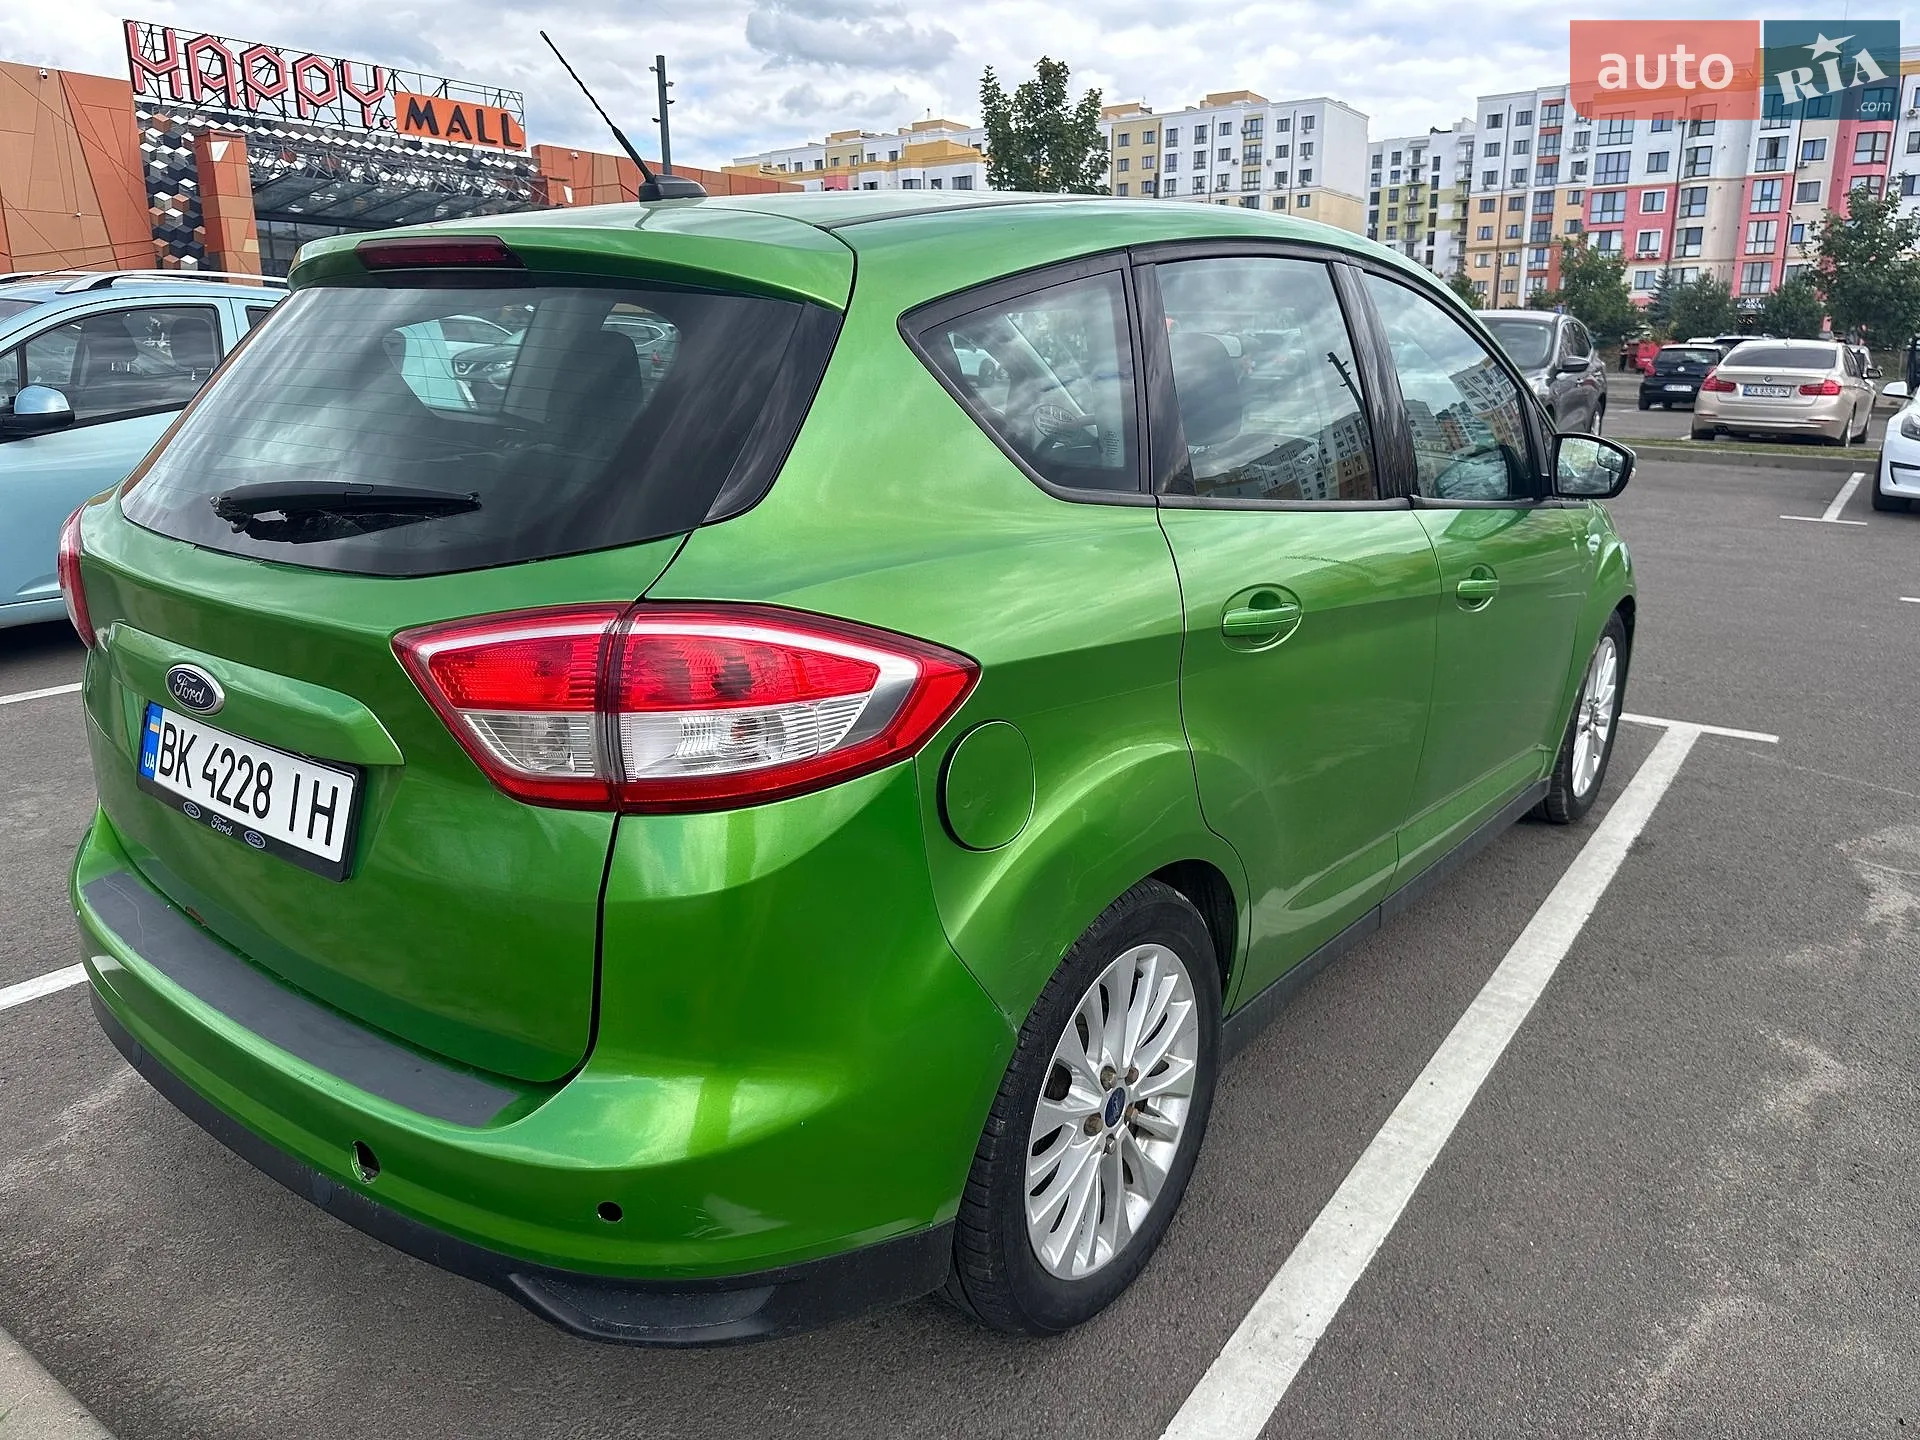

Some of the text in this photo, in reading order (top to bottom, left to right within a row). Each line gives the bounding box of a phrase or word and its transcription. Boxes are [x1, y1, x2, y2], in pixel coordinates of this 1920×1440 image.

[404, 98, 522, 149] MALL
[173, 672, 205, 705] Ford
[144, 751, 155, 771] UA
[158, 721, 339, 847] BK 4228 IH
[210, 814, 233, 837] Ford
